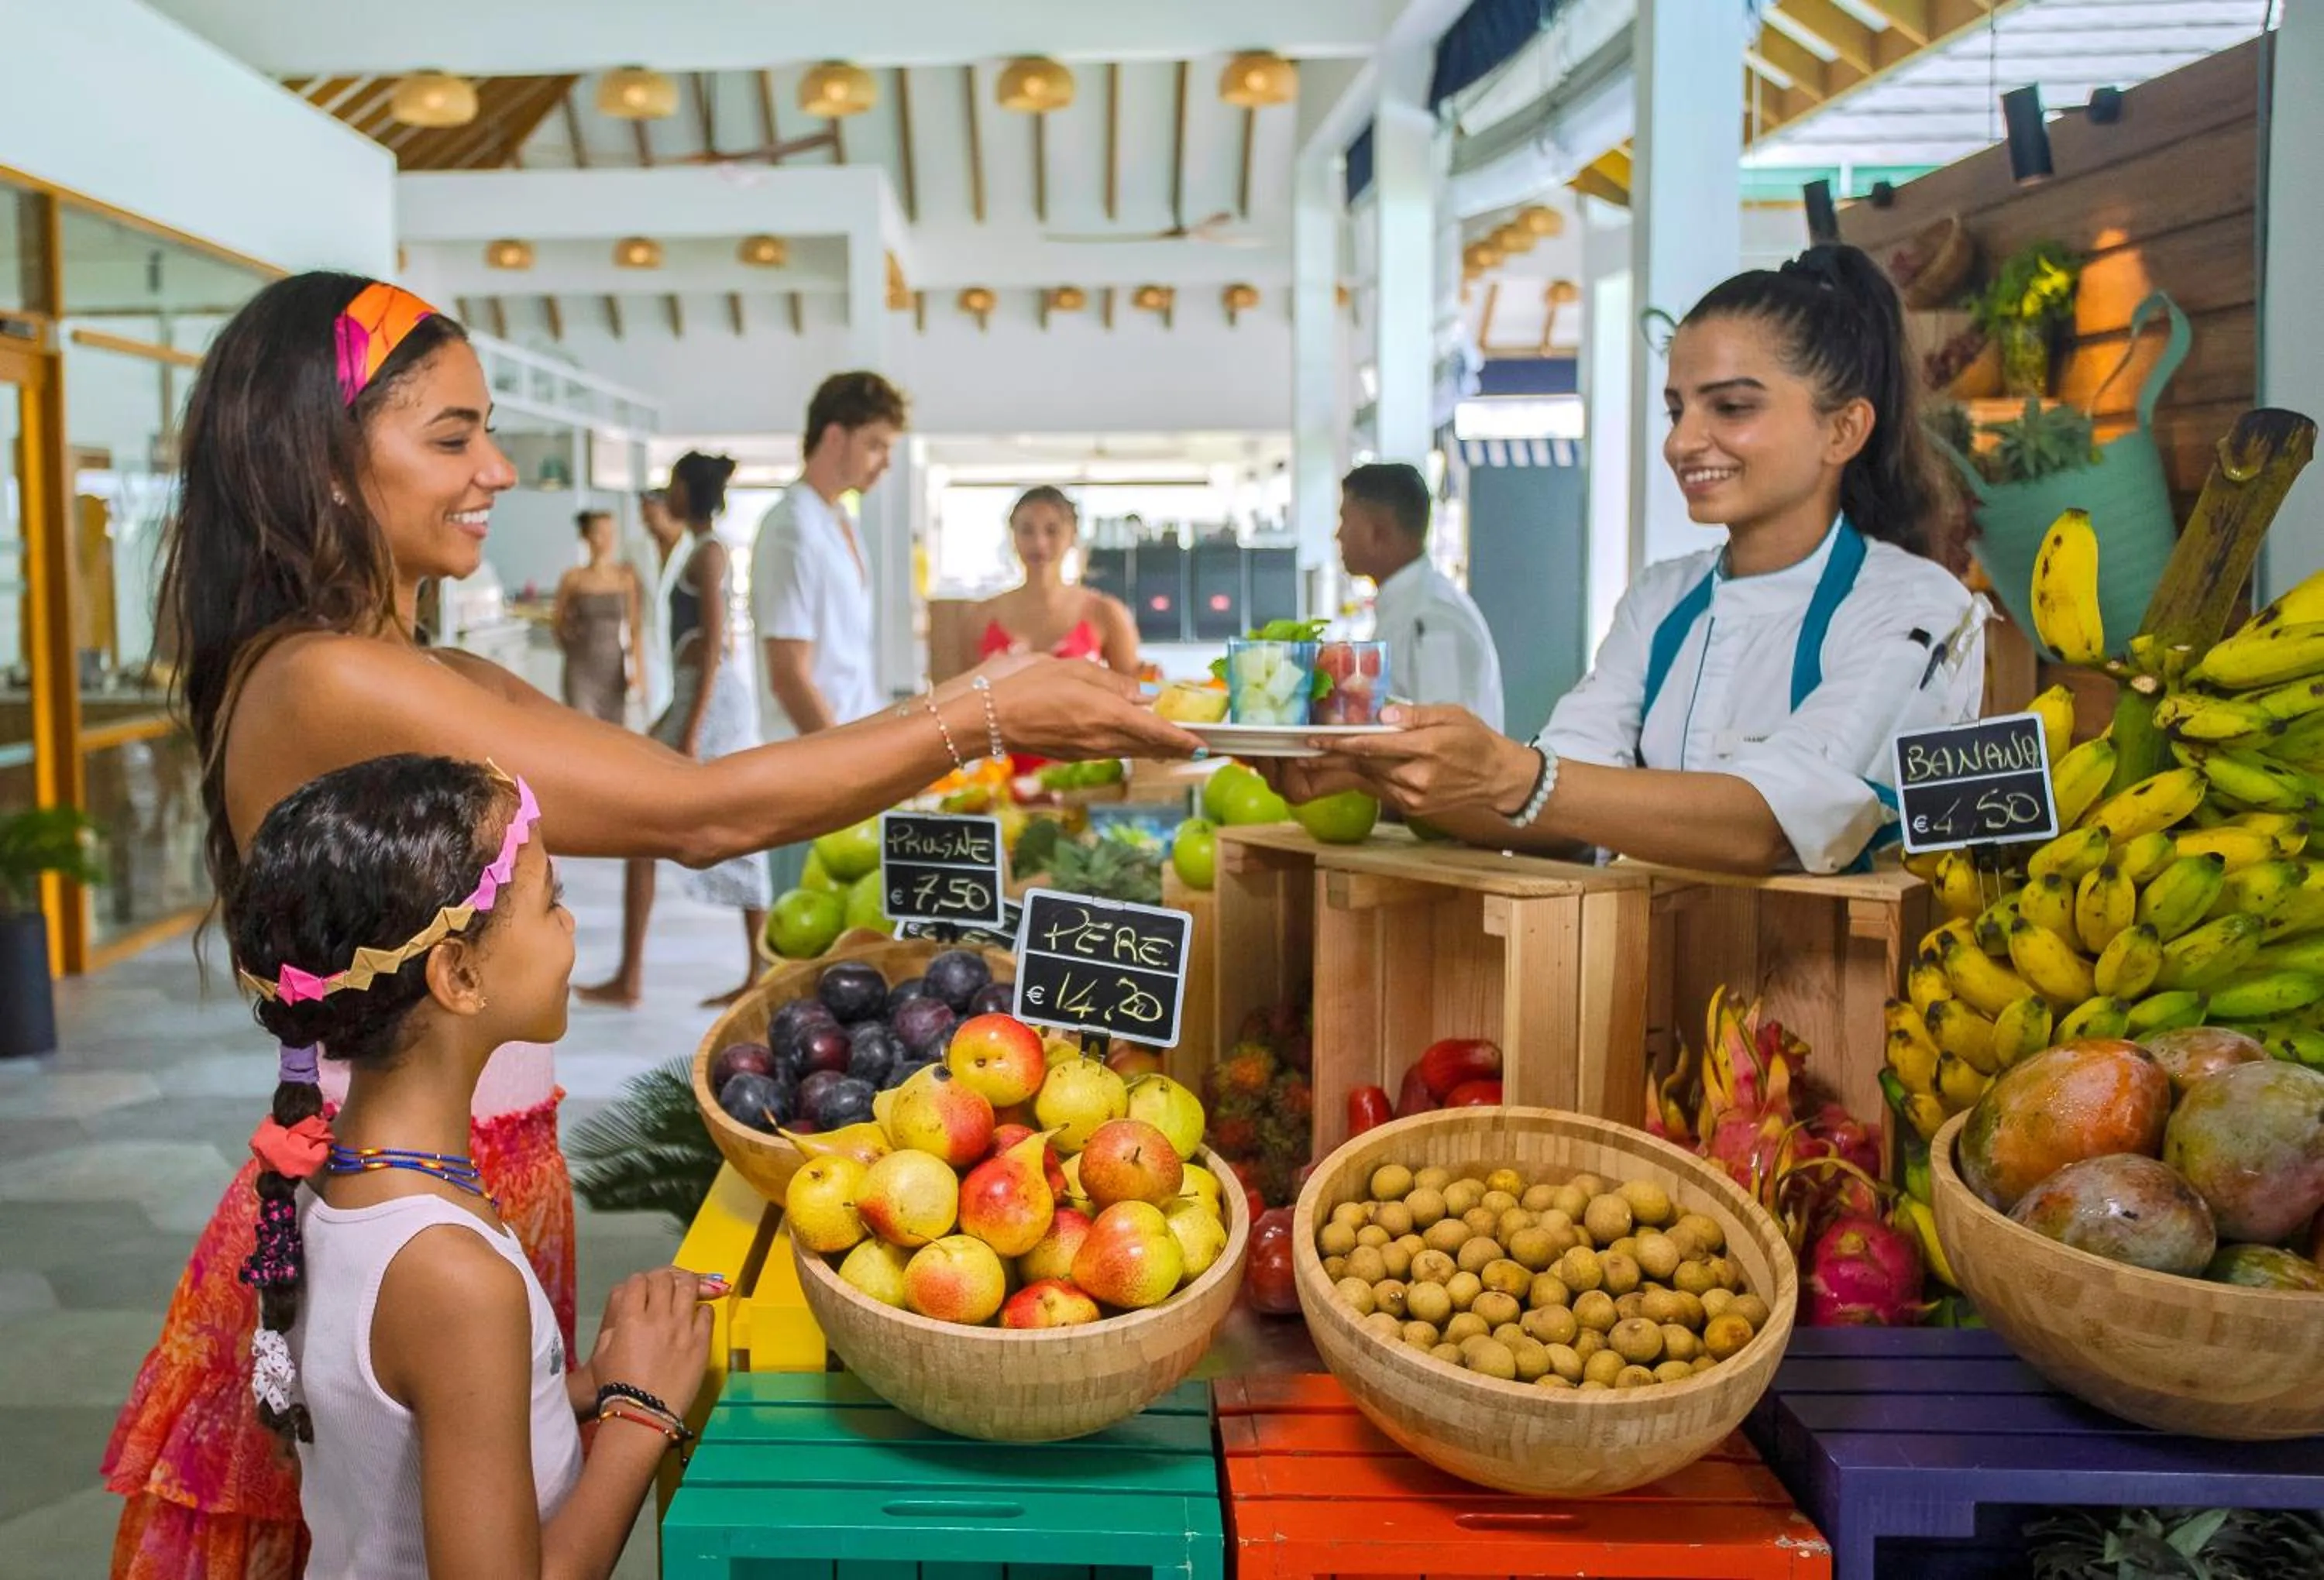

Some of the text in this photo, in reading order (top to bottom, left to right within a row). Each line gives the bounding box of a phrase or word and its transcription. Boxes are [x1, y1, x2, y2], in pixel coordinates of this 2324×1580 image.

[1906, 730, 2039, 781] BANANA
[1913, 815, 1928, 833] €
[890, 873, 991, 914] € 7,50
[1043, 907, 1175, 967] PERE
[1026, 971, 1163, 1022] € 14,20
